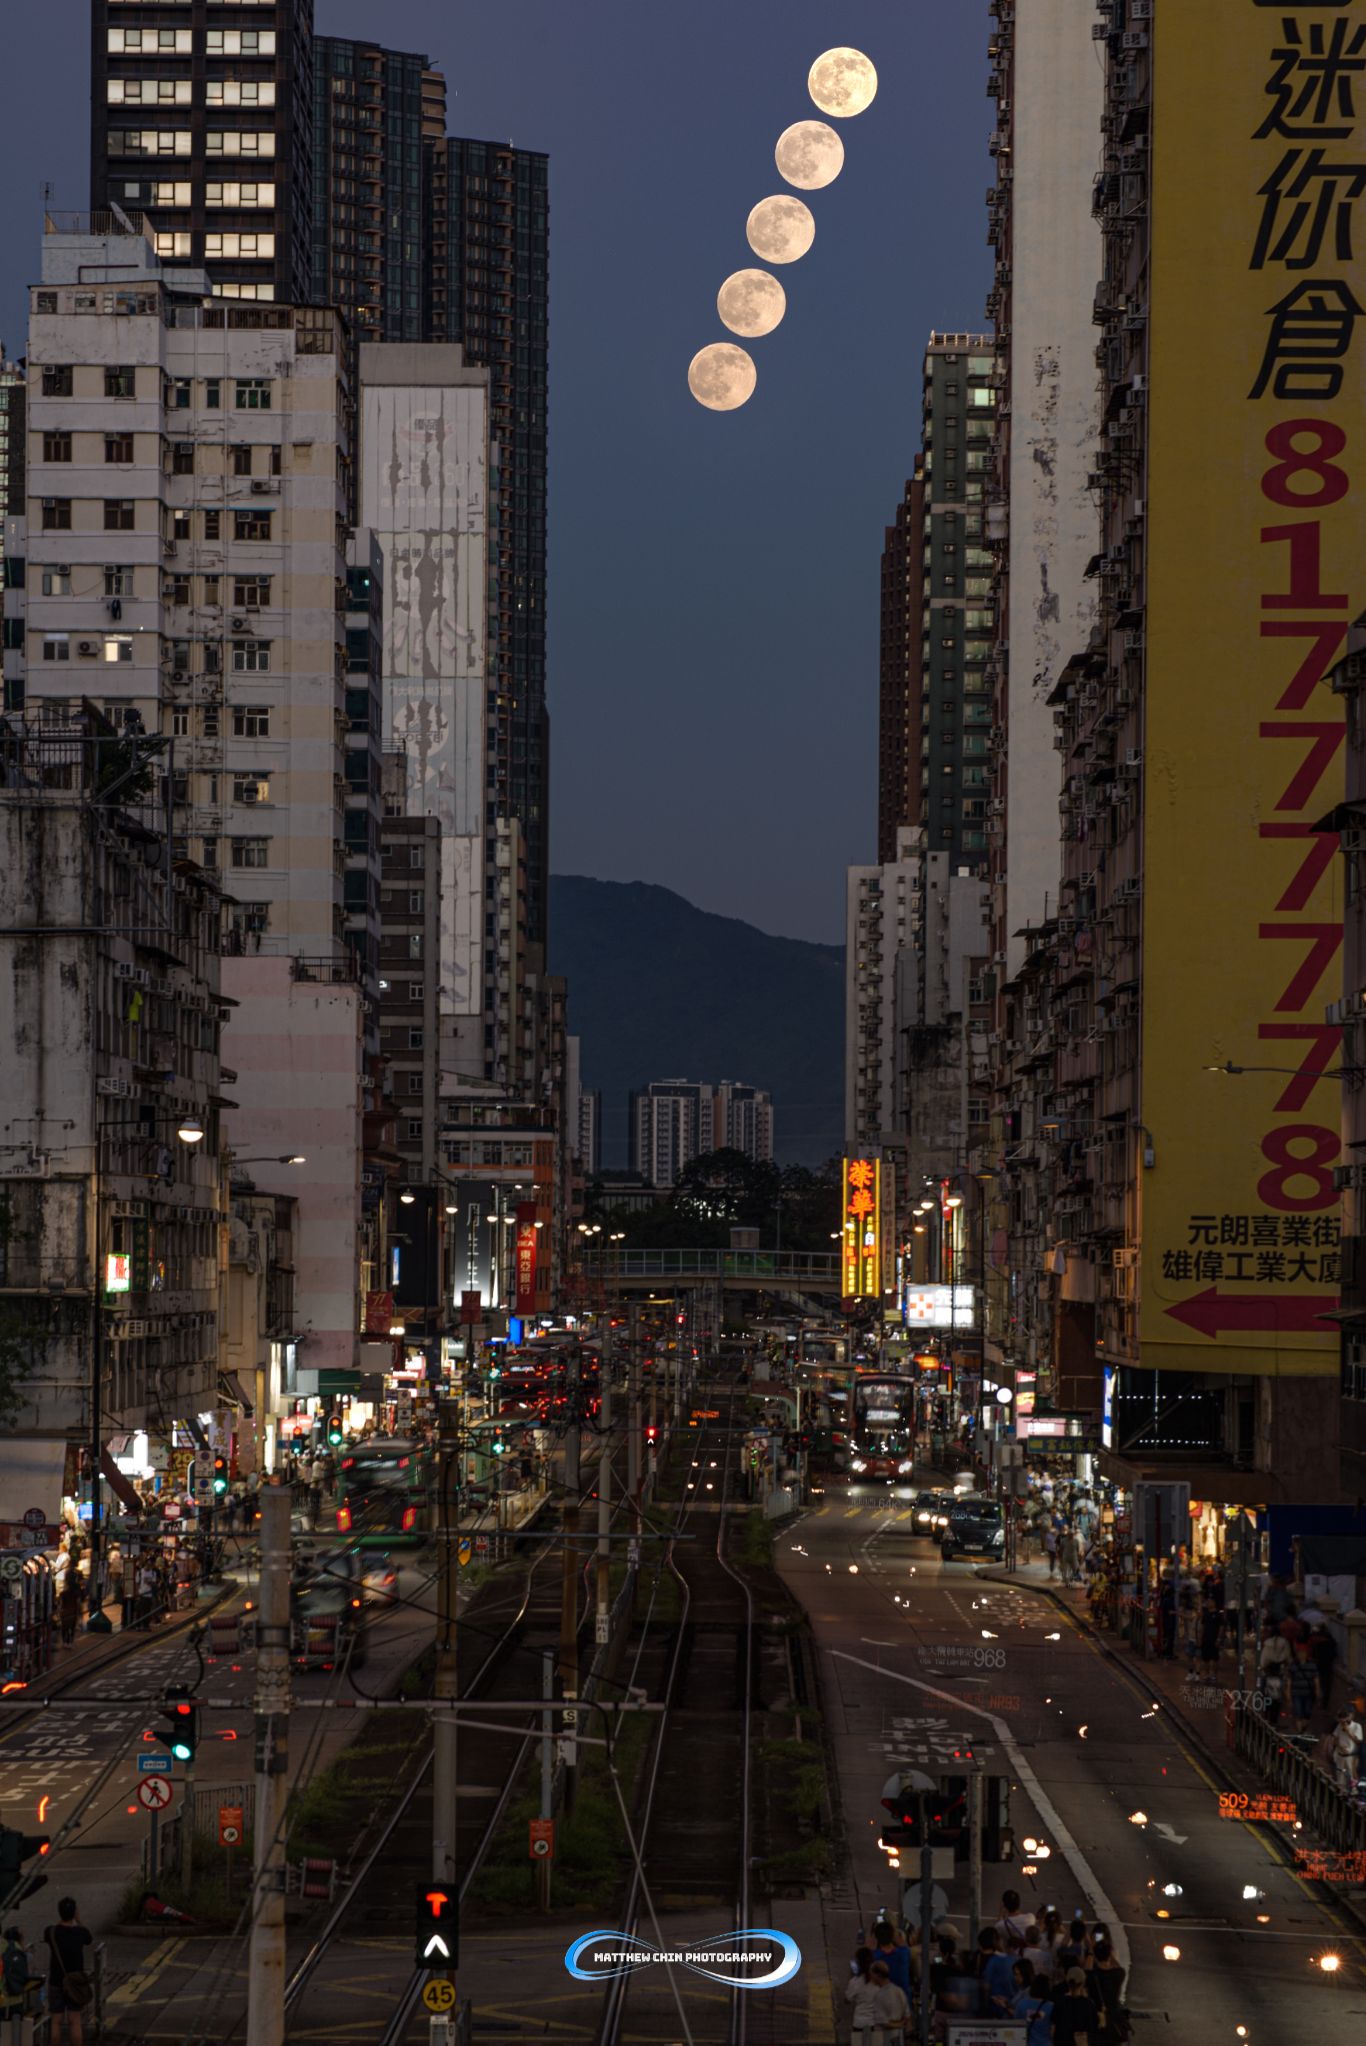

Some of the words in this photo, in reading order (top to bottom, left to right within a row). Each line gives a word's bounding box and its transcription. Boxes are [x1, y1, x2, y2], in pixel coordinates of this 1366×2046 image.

[1247, 0, 1366, 400] 迷你倉
[1188, 1215, 1341, 1248] 元朗喜業街
[519, 1249, 531, 1296] 東亞銀行
[1162, 1250, 1344, 1283] 雄偉工業大廈
[973, 1648, 1006, 1669] 968
[427, 1985, 452, 2004] 45
